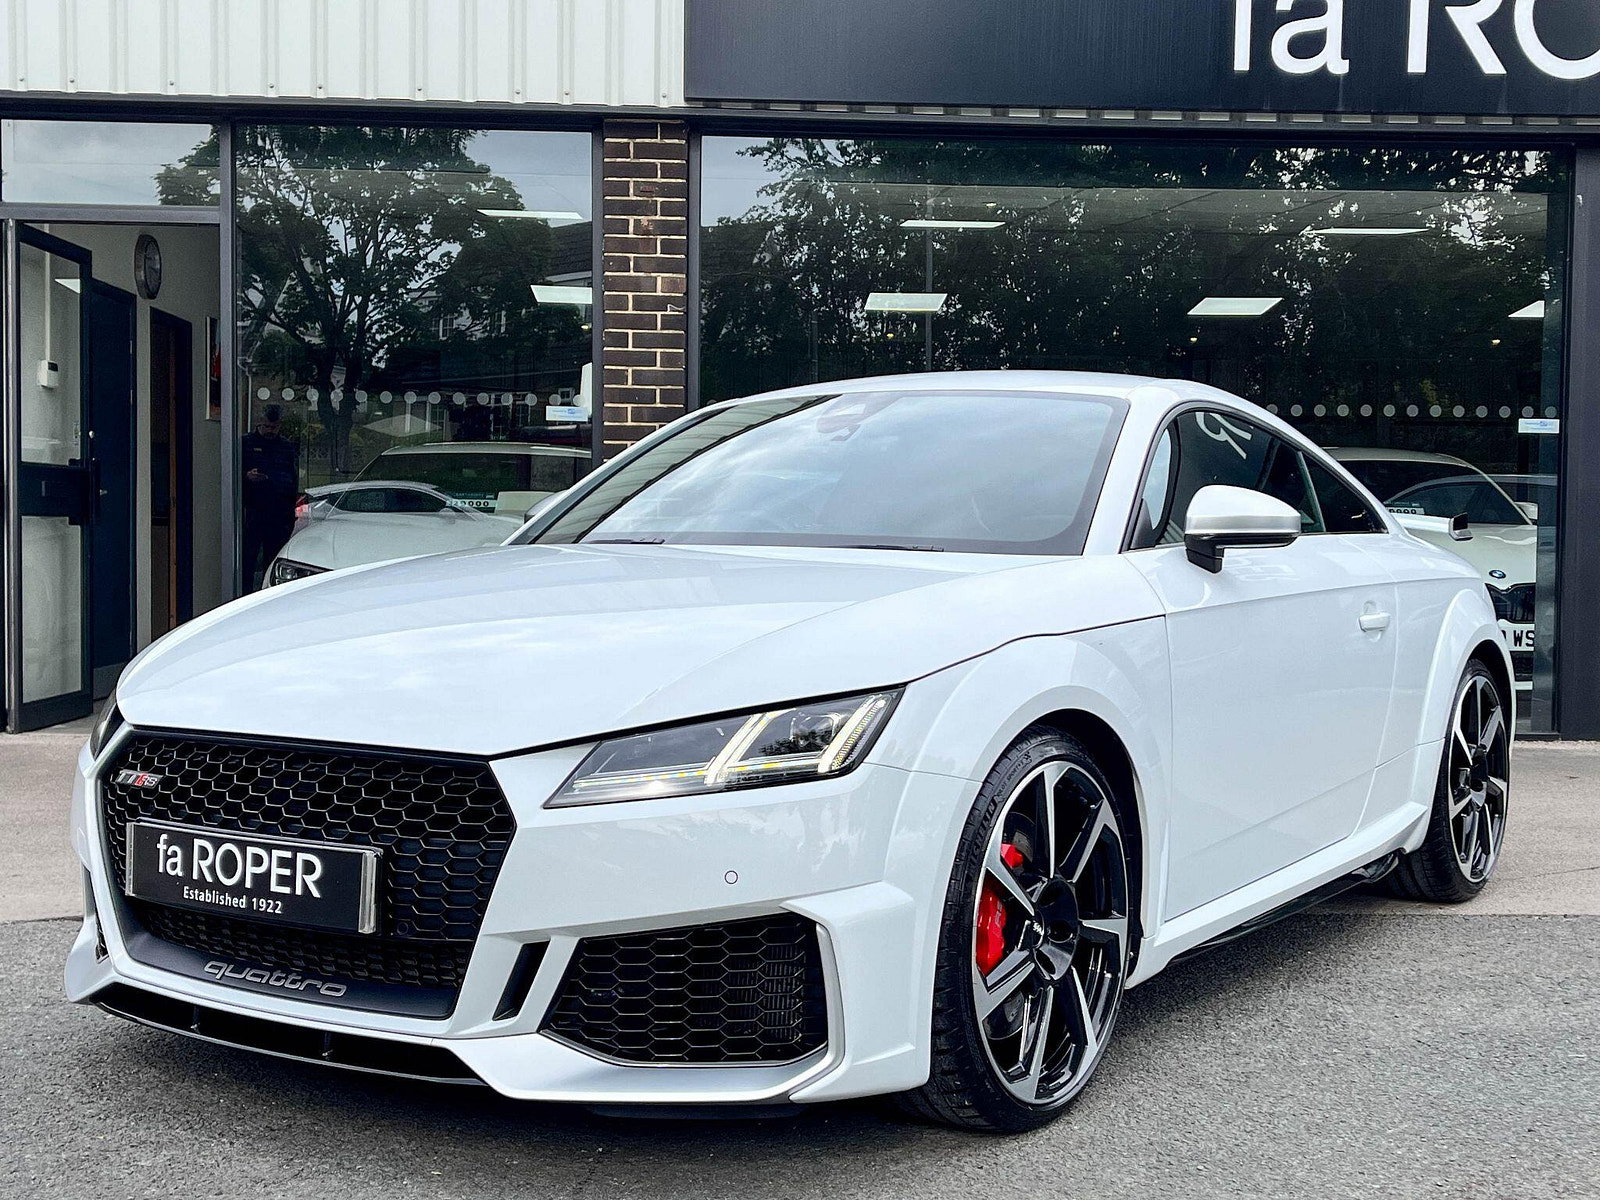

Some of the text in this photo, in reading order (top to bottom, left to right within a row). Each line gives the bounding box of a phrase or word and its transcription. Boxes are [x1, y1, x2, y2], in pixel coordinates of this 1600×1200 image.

[156, 833, 322, 898] fa ROPER
[183, 886, 283, 914] Established 1922
[203, 961, 347, 997] quattro
